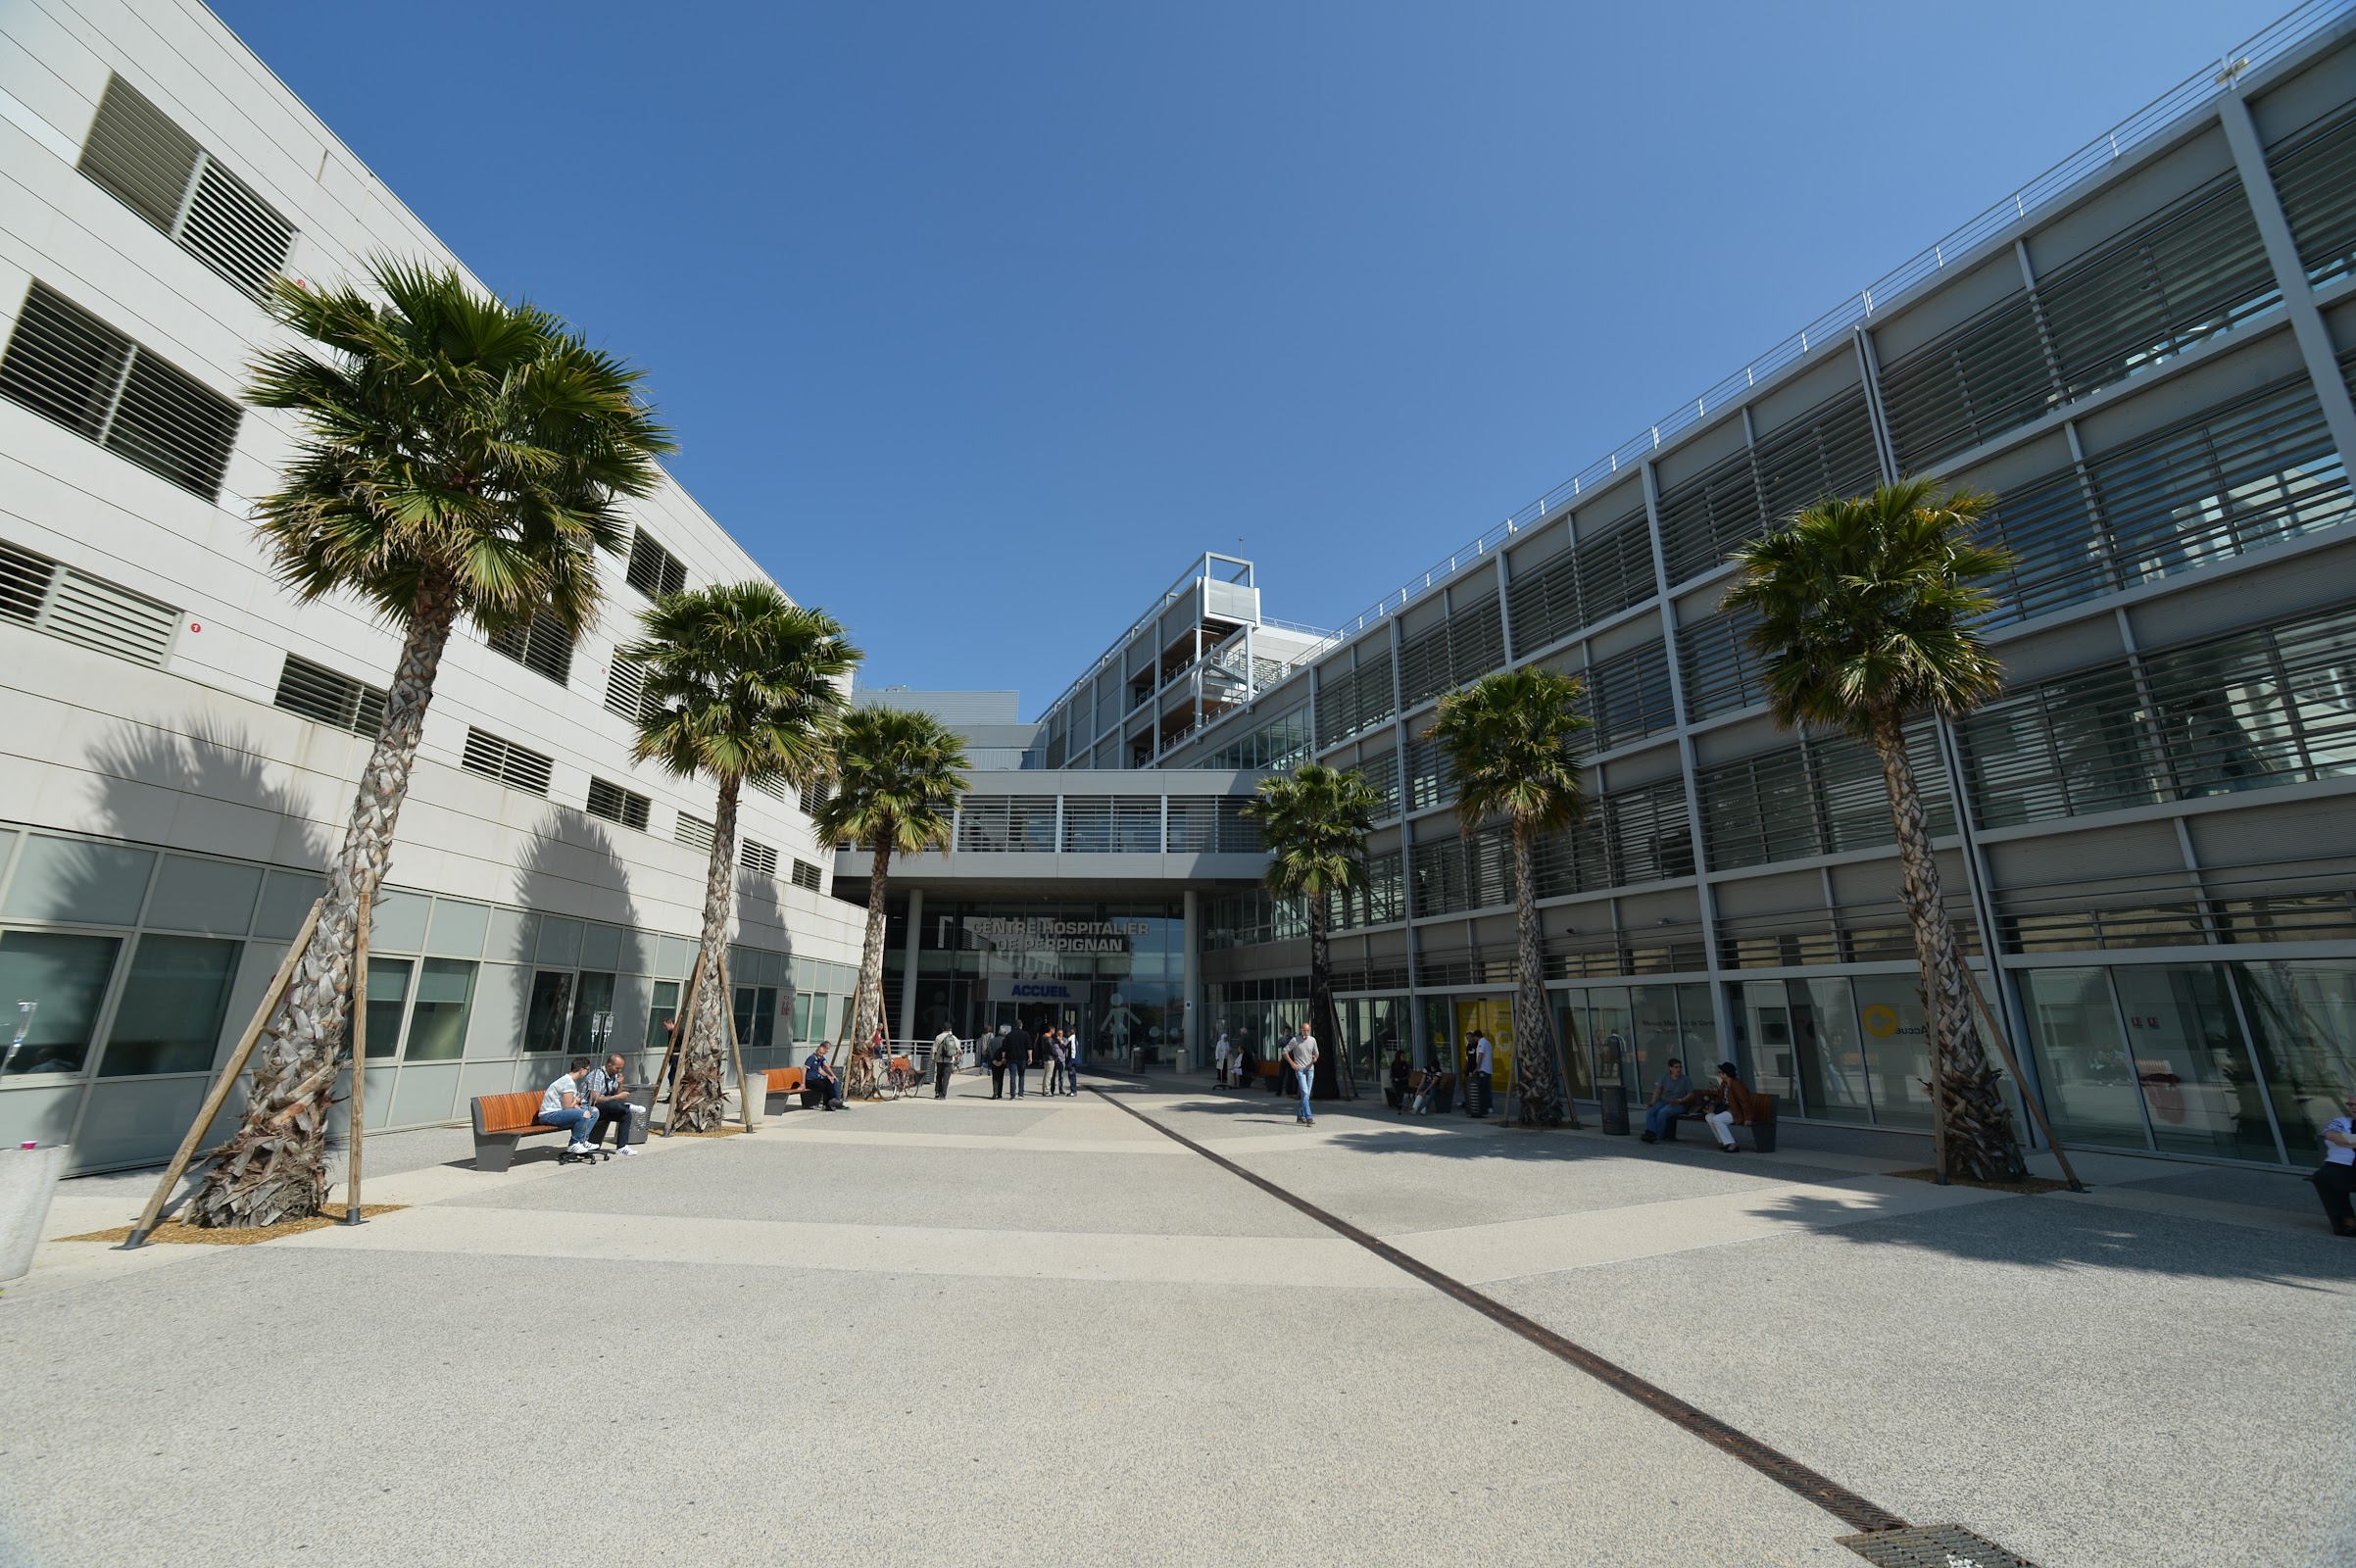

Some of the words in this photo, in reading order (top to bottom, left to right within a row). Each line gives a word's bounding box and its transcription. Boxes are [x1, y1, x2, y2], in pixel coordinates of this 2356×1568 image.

[972, 921, 1041, 934] CENTRE
[1042, 922, 1150, 935] HOSPITALIER
[997, 938, 1019, 951] DE
[1026, 938, 1123, 952] PERPIGNAN
[1011, 984, 1070, 998] ACCUEIL
